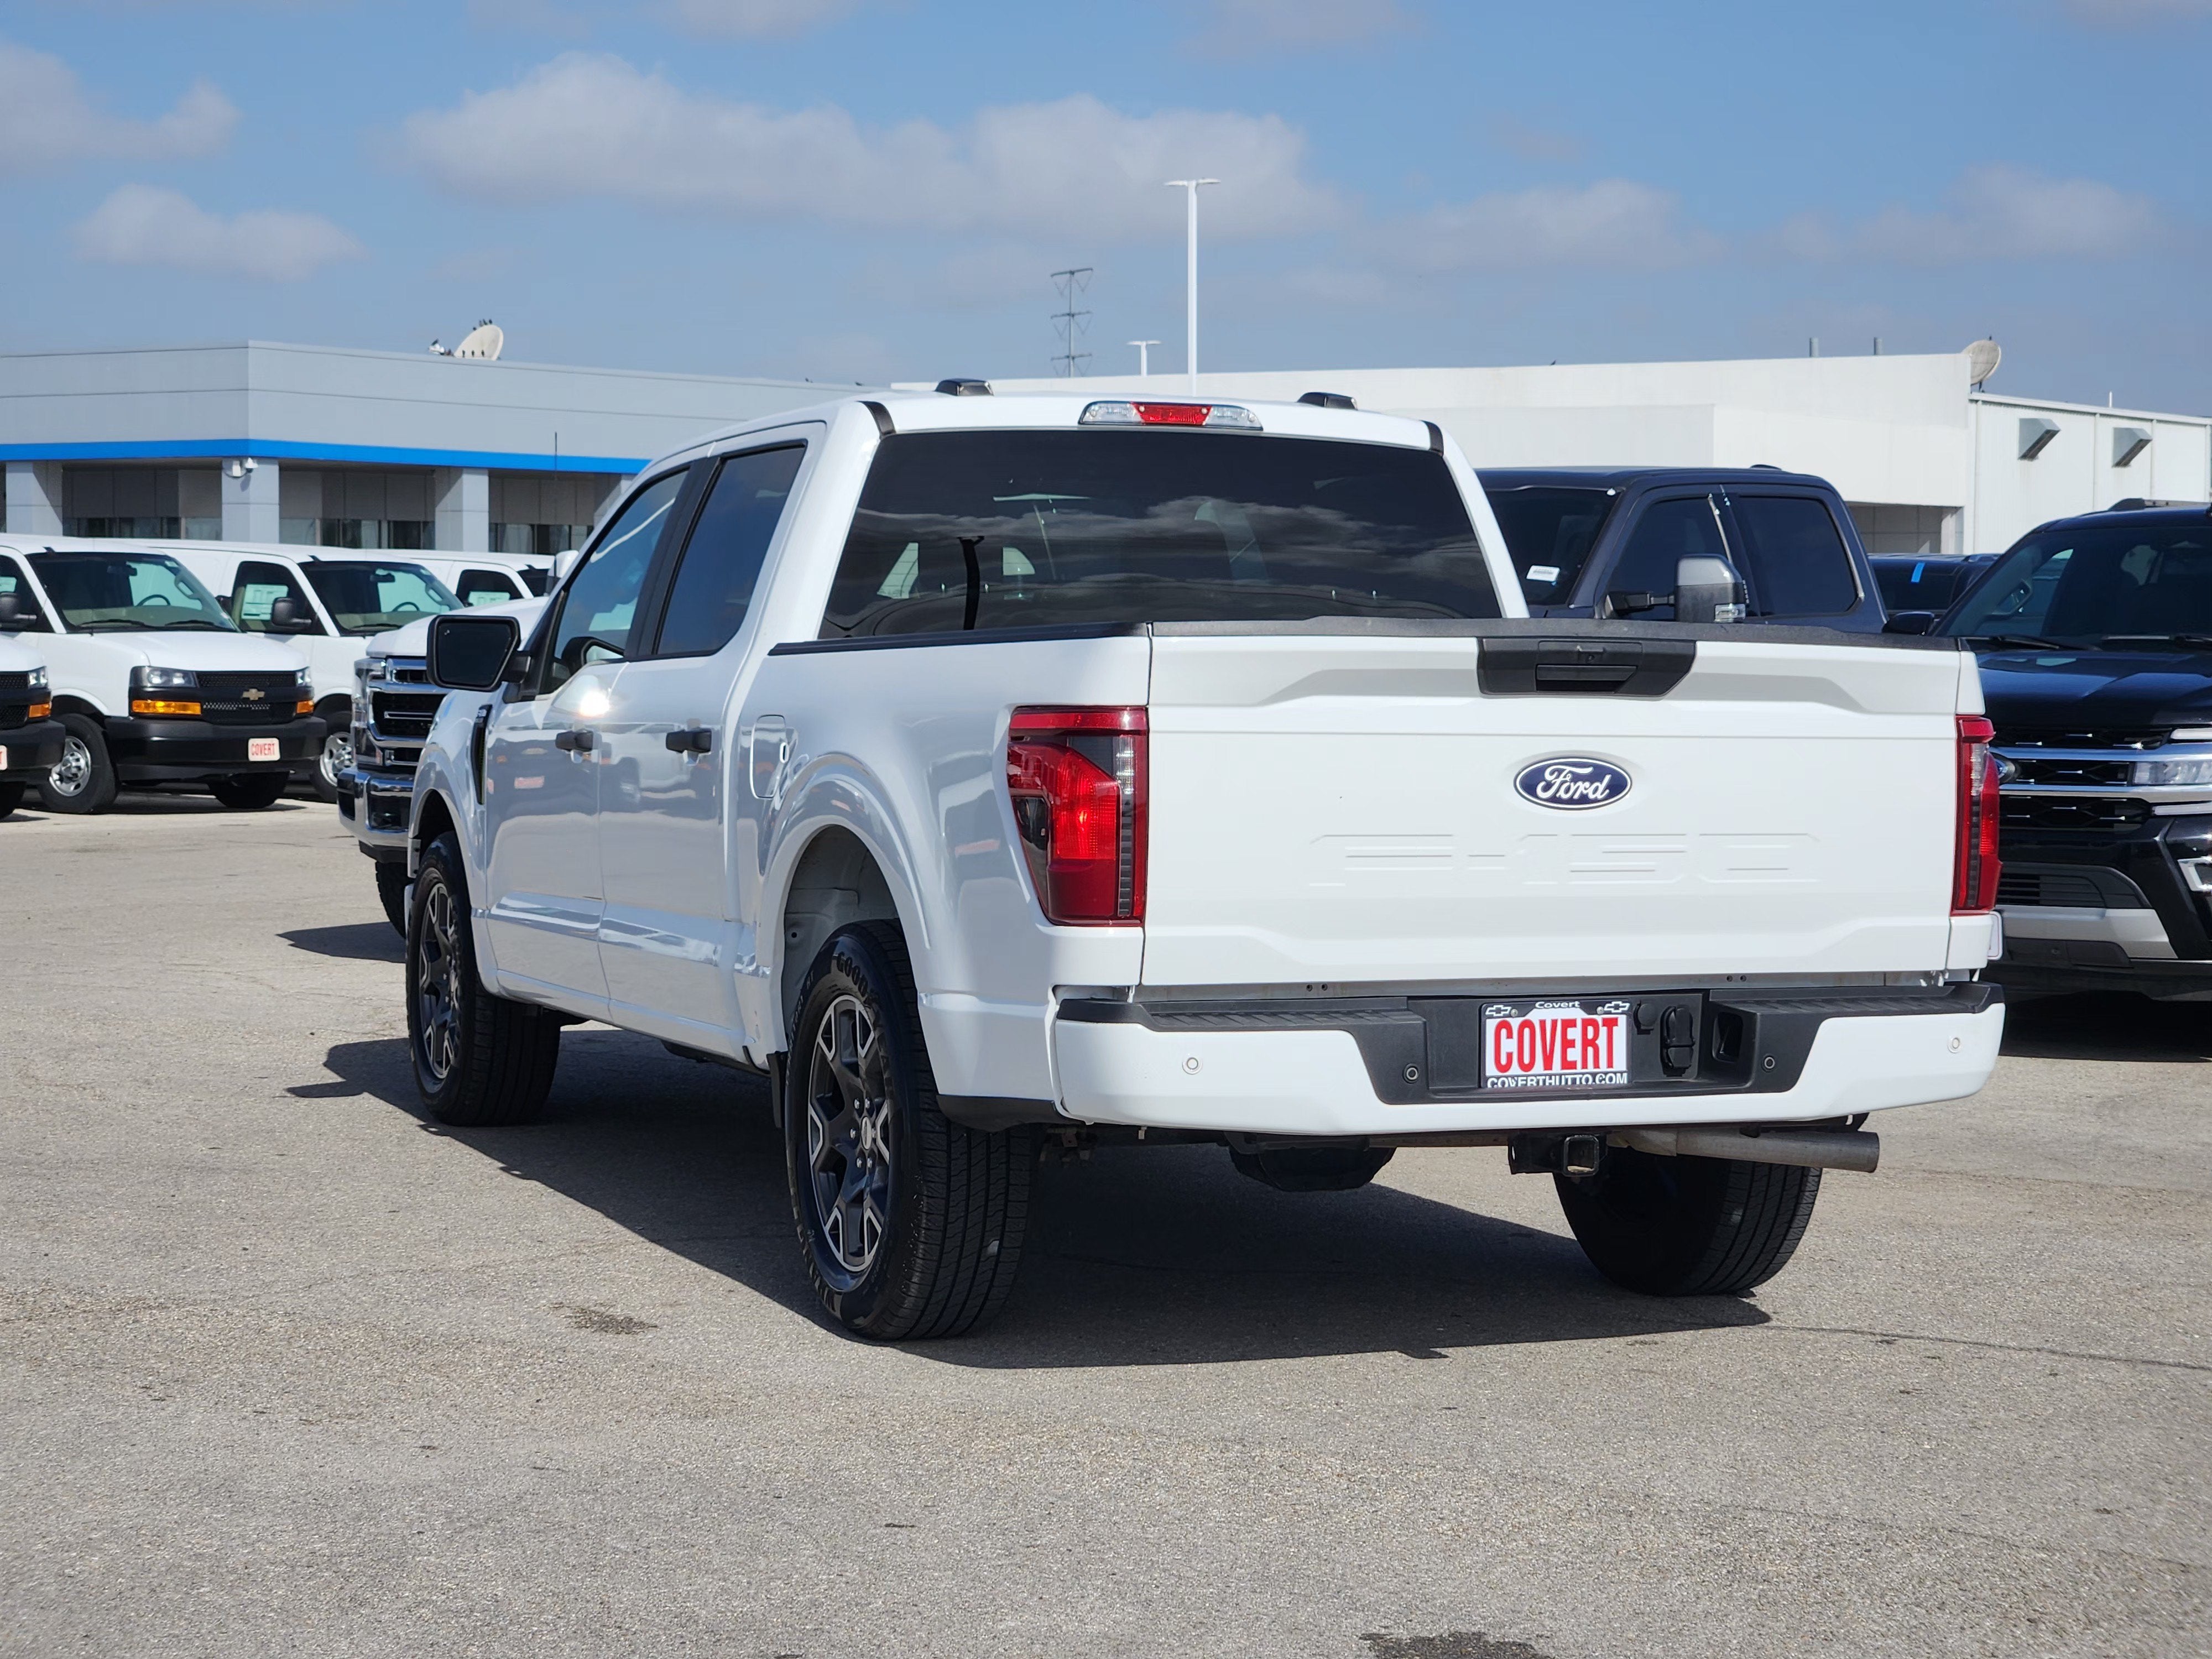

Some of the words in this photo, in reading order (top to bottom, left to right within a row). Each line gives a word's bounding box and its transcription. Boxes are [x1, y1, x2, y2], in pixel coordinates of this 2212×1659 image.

[251, 743, 275, 756] COVERT
[1536, 765, 1612, 799] Ford
[1494, 1018, 1619, 1073] COVERT
